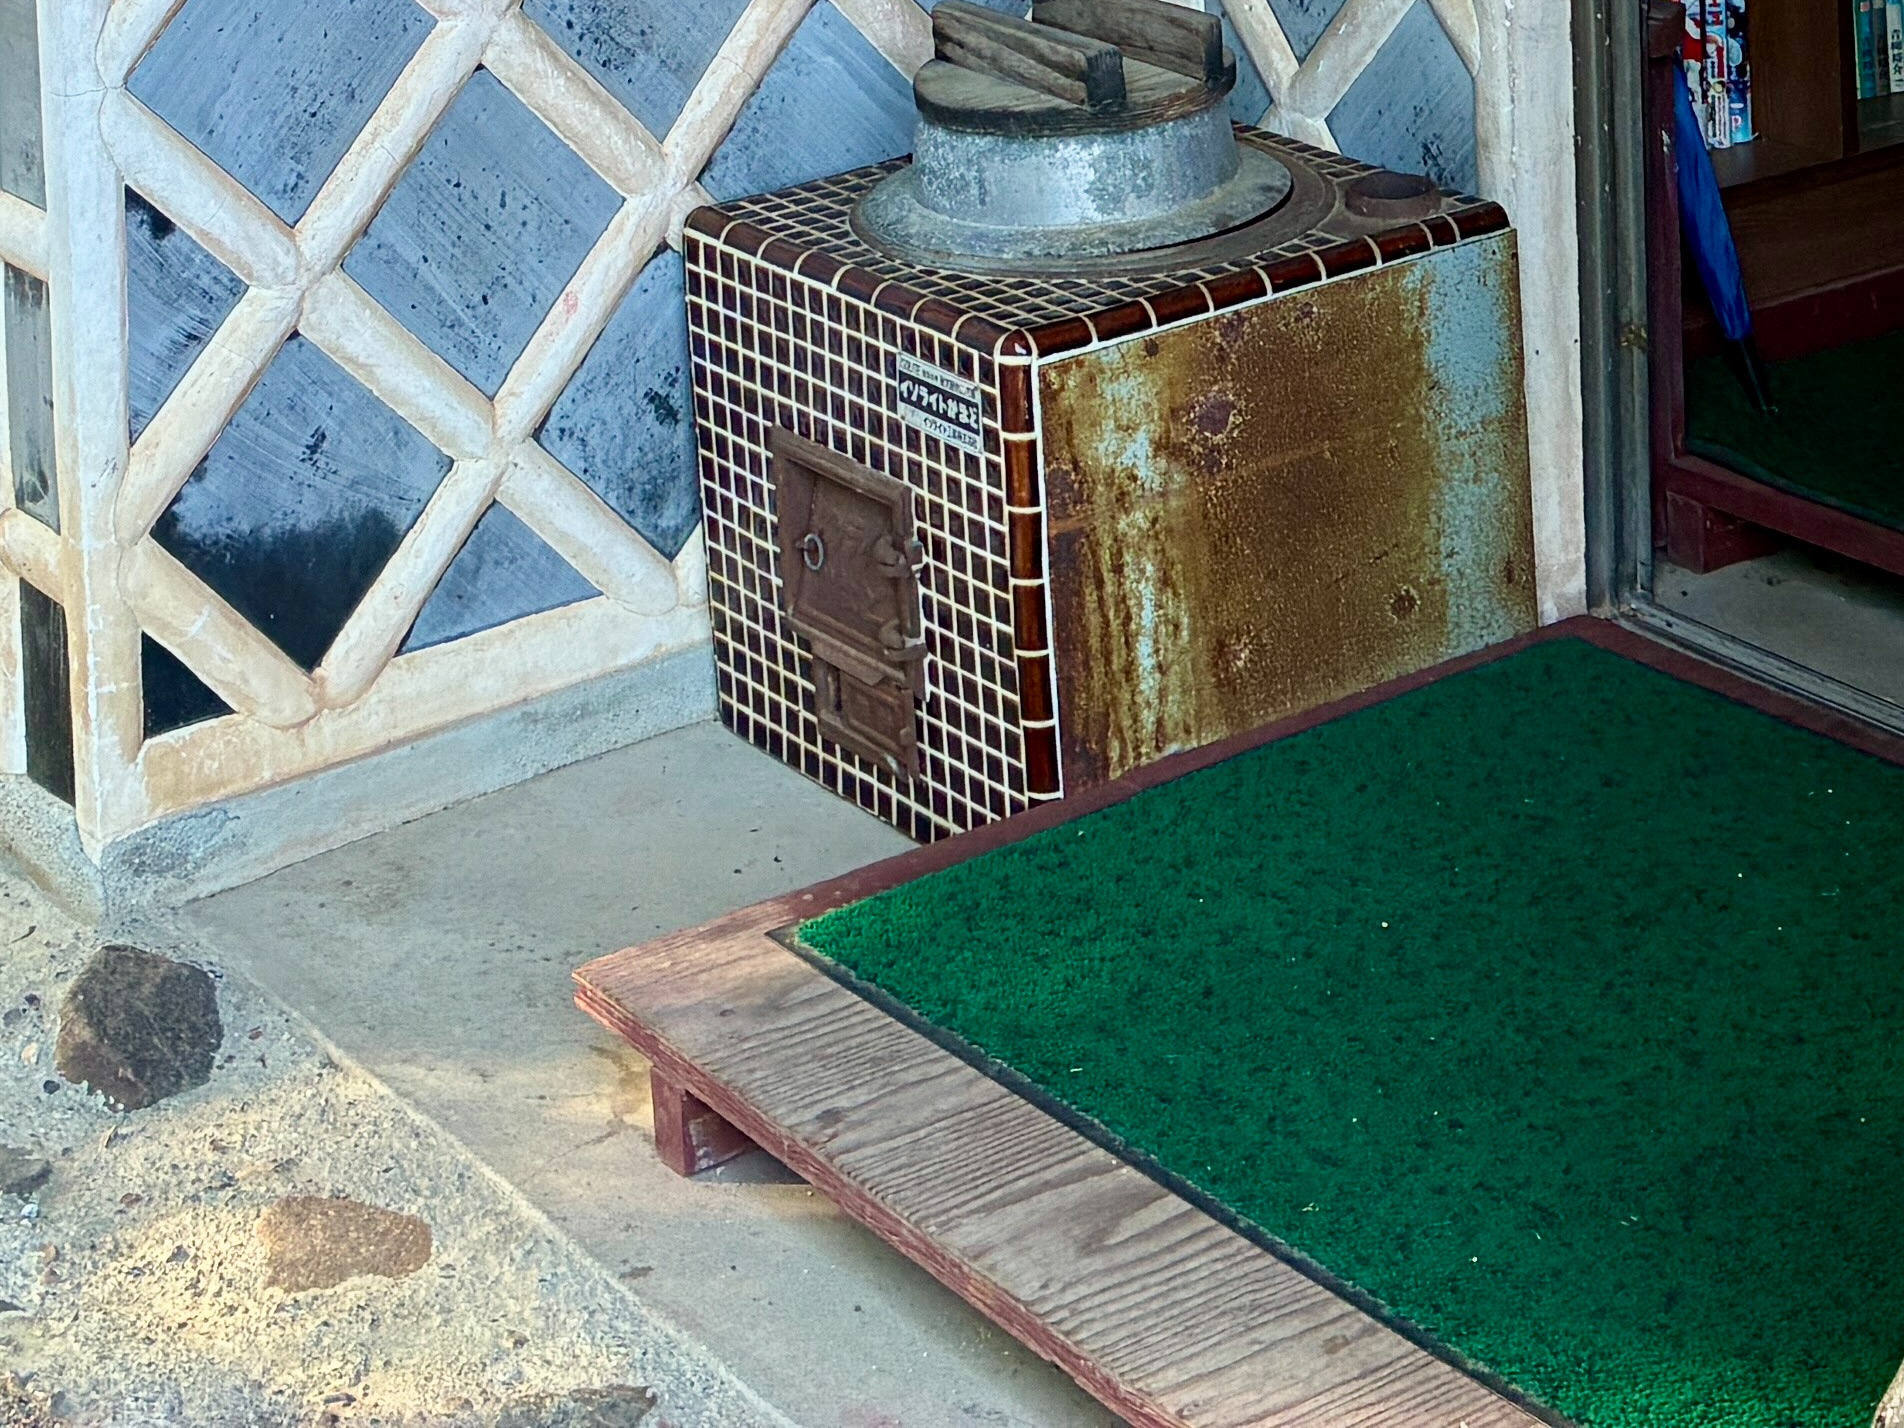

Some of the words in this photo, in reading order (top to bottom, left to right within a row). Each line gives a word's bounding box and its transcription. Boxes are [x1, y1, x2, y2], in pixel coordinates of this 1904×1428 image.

[900, 380, 979, 430] イソライトかまど
